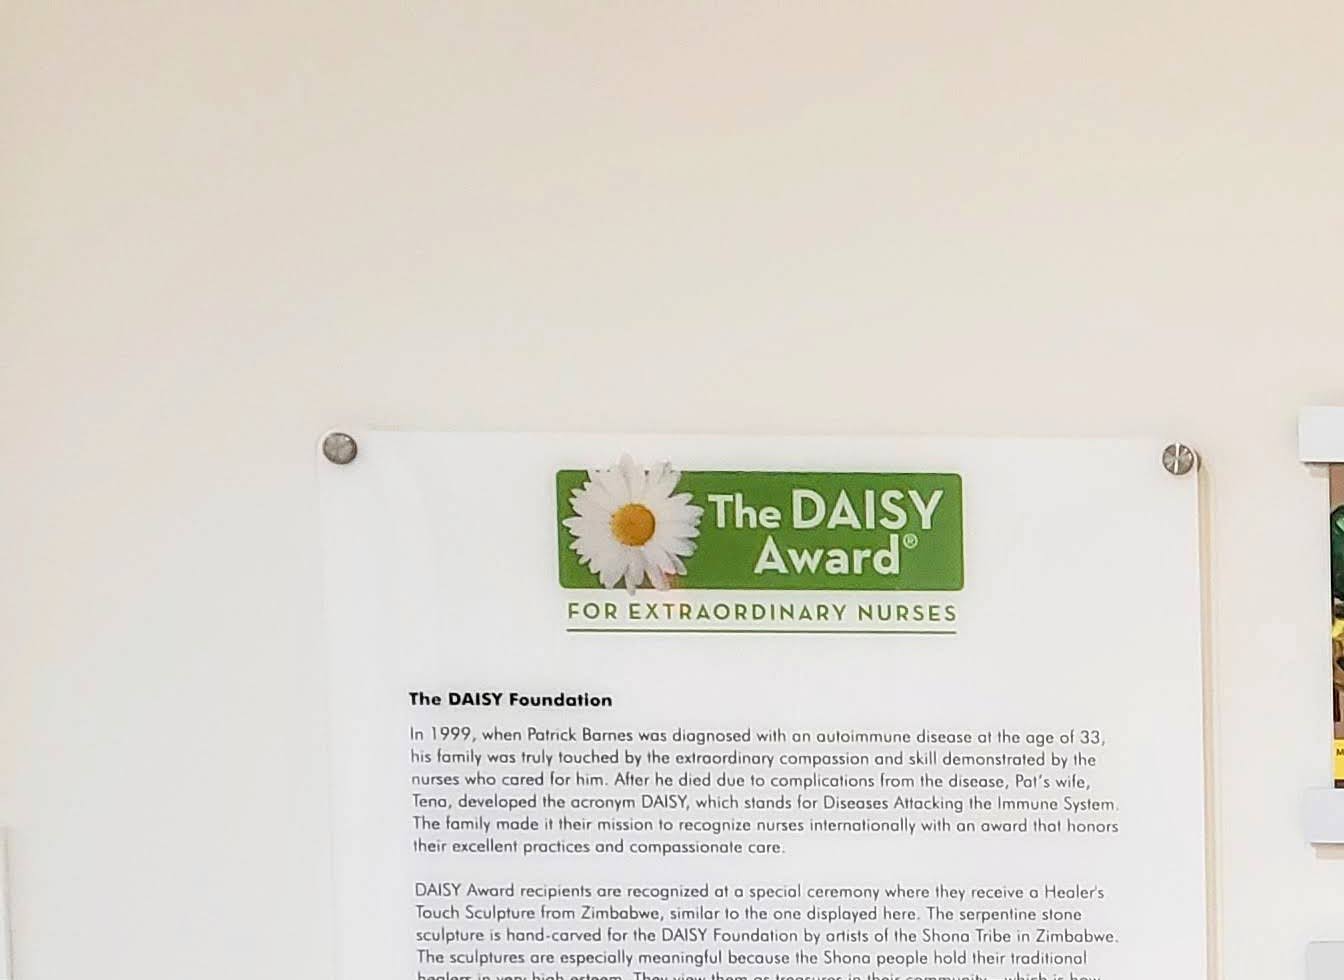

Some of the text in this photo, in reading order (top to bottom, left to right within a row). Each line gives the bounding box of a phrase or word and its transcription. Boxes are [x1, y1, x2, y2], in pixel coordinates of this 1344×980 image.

[706, 488, 943, 529] The DAISY
[568, 602, 956, 621] FOR EXTRAORDINARY NURSES
[408, 691, 612, 707] The DAISY Foundation
